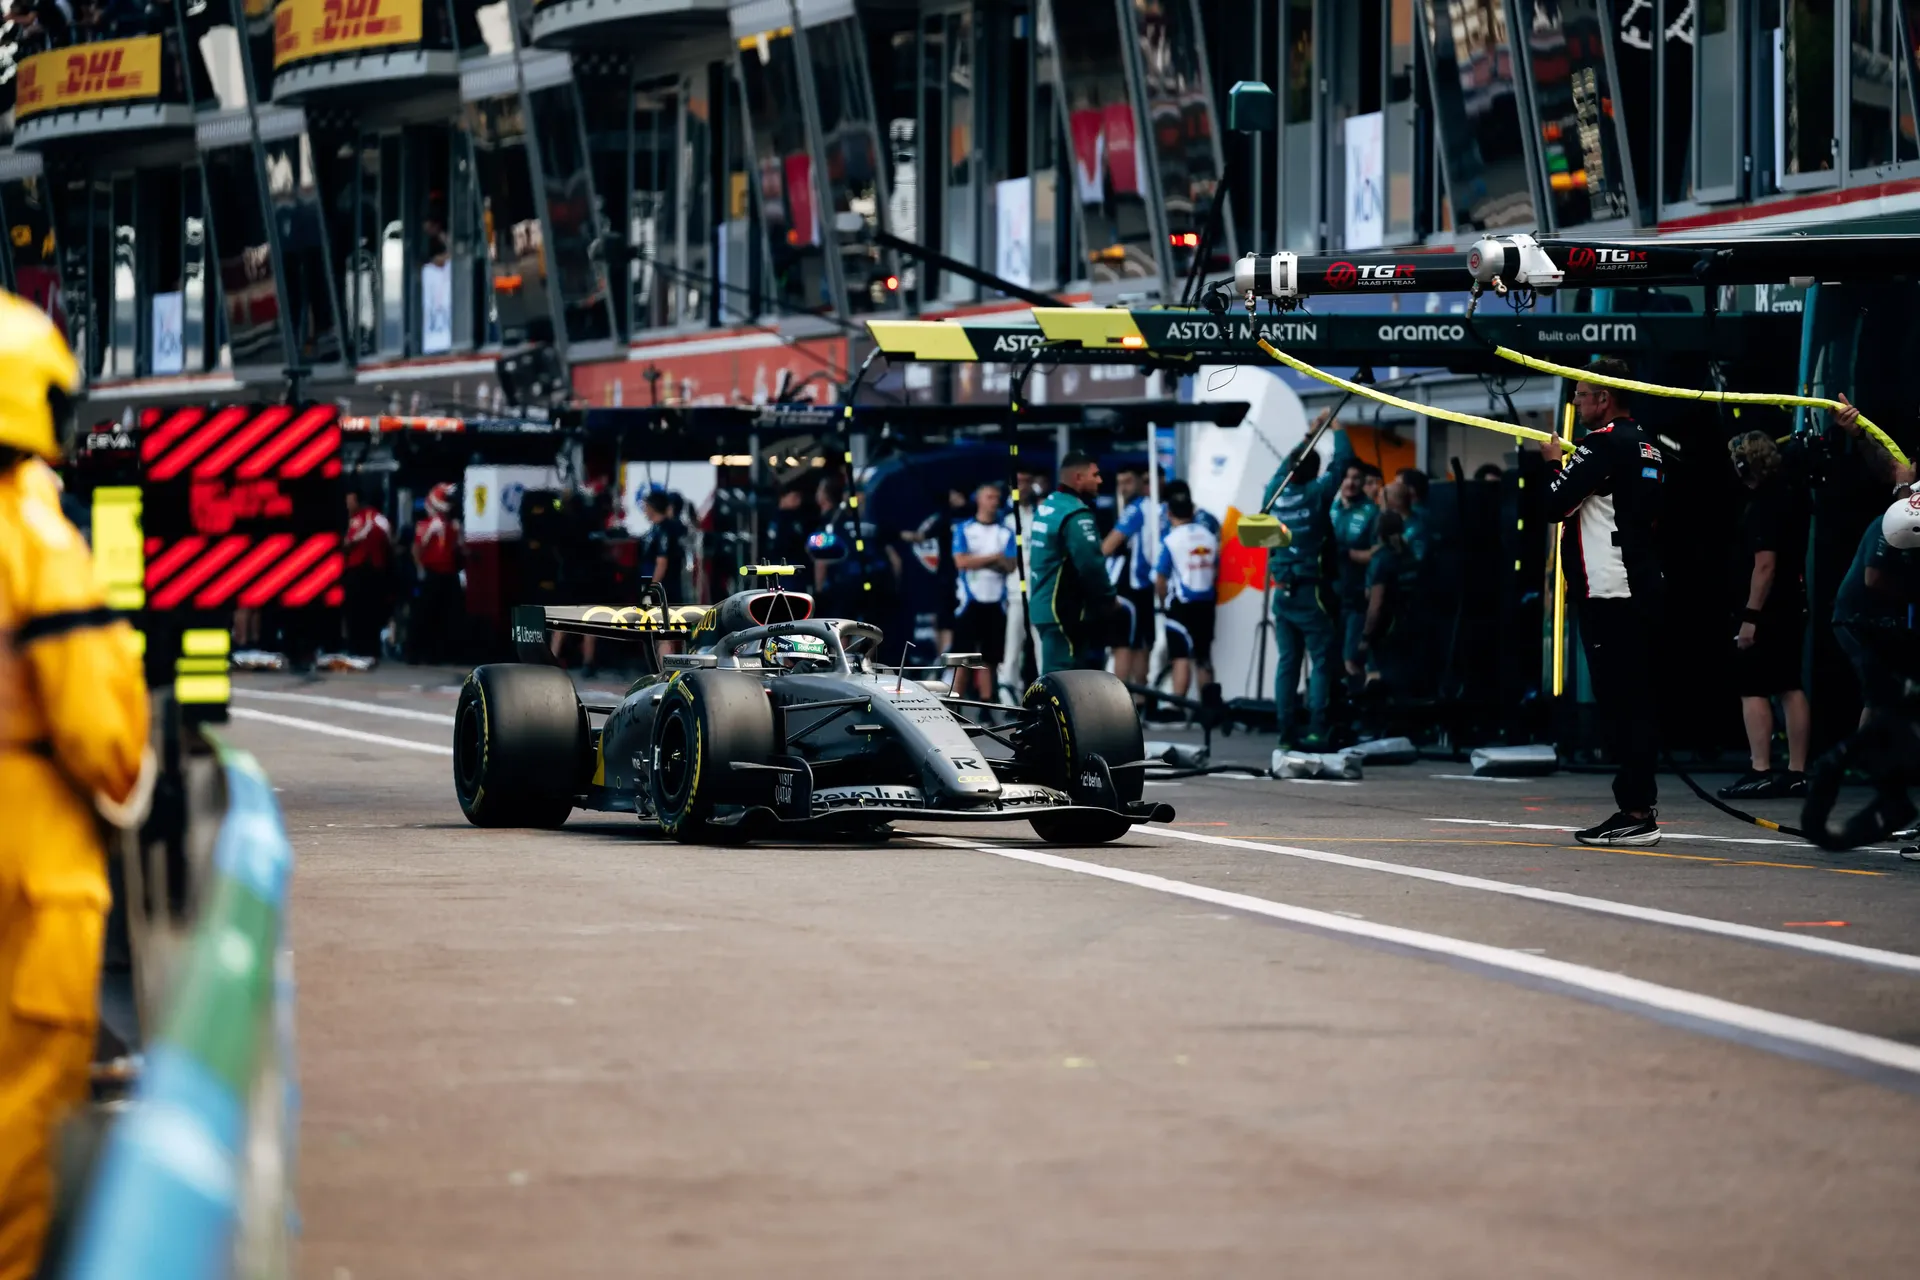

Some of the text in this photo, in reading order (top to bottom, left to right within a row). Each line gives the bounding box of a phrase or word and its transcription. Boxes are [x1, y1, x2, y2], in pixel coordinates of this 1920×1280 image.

[65, 48, 127, 95] DHL
[1357, 264, 1416, 279] TGR
[1378, 324, 1465, 341] aramco
[1538, 323, 1637, 342] Built on arm
[768, 623, 795, 633] Gillette
[951, 757, 982, 770] R
